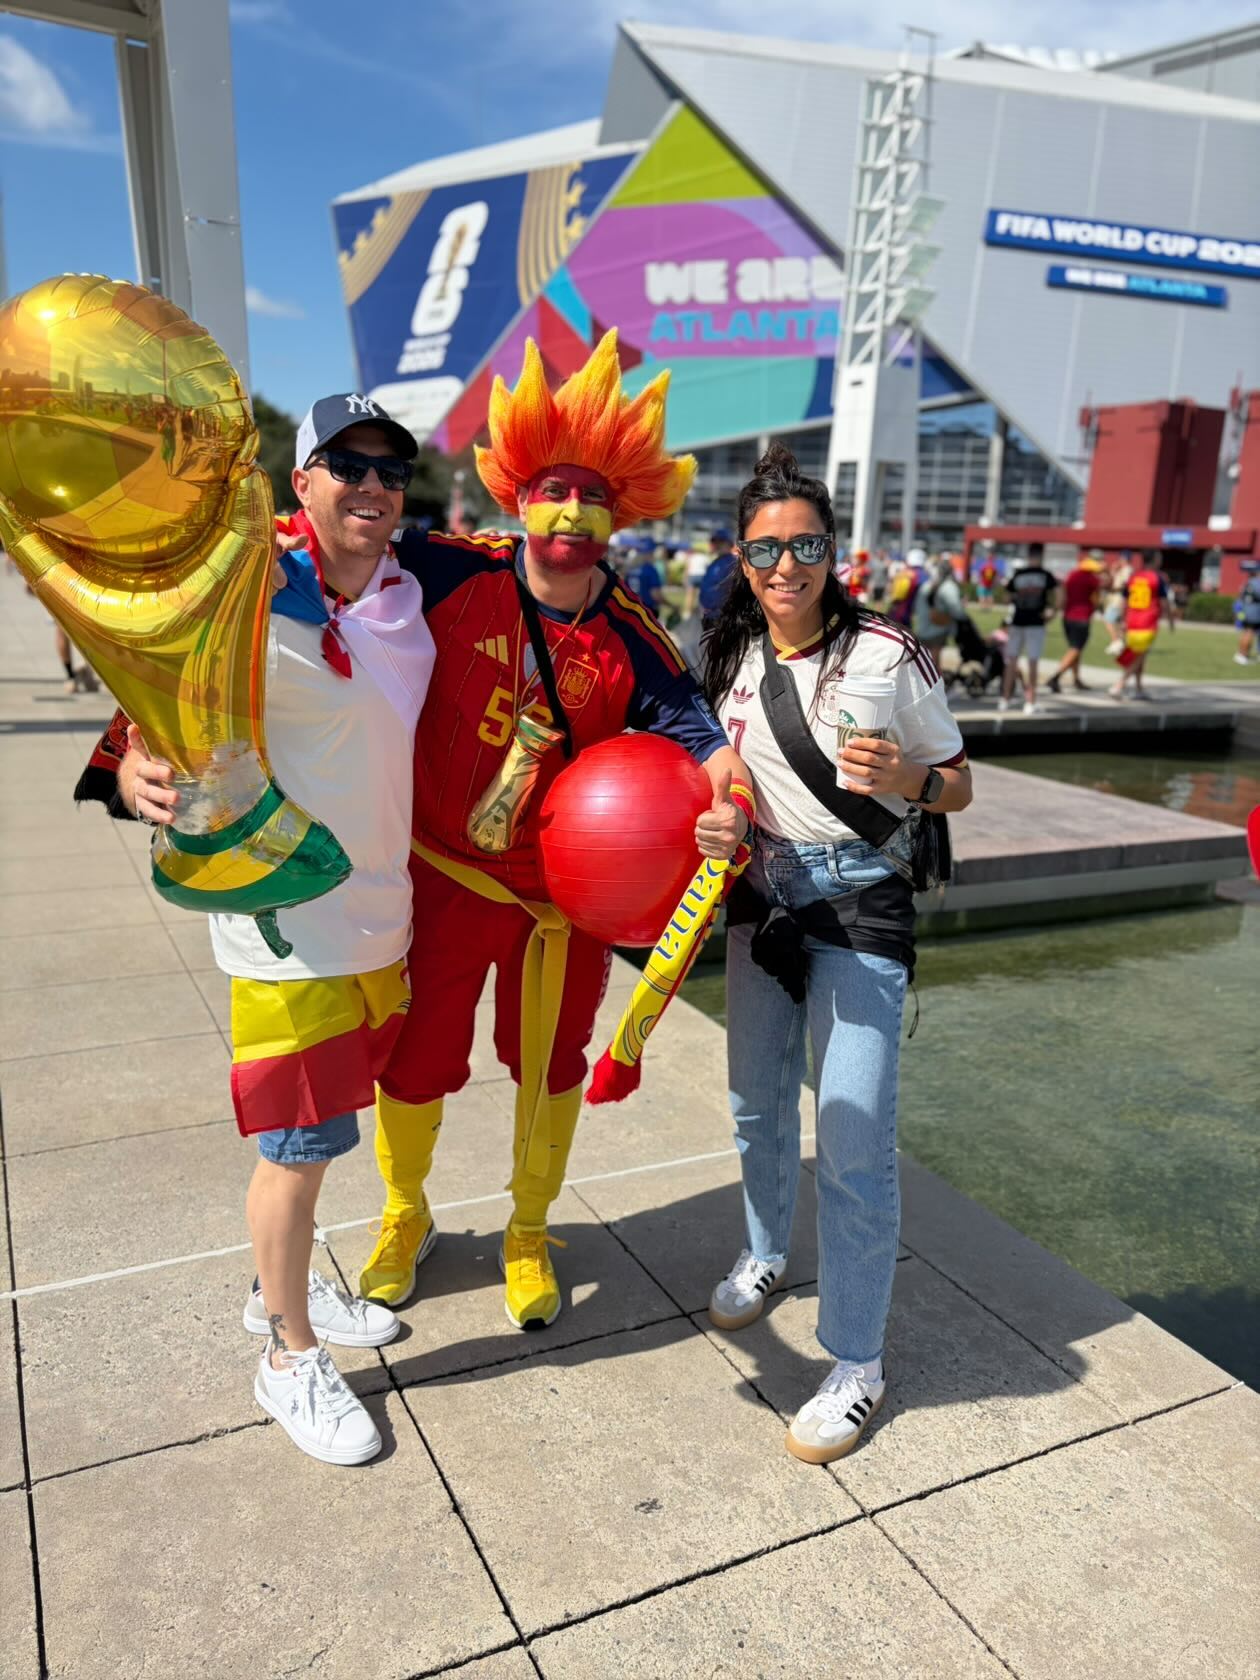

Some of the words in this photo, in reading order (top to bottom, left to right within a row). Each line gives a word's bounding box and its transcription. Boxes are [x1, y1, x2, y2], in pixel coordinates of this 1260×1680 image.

[996, 213, 1051, 239] FIFA
[1052, 219, 1144, 251] WORLD
[1145, 232, 1197, 257] CUP
[645, 260, 729, 305] WE
[650, 310, 839, 342] ATLANTA
[345, 393, 379, 417] NY
